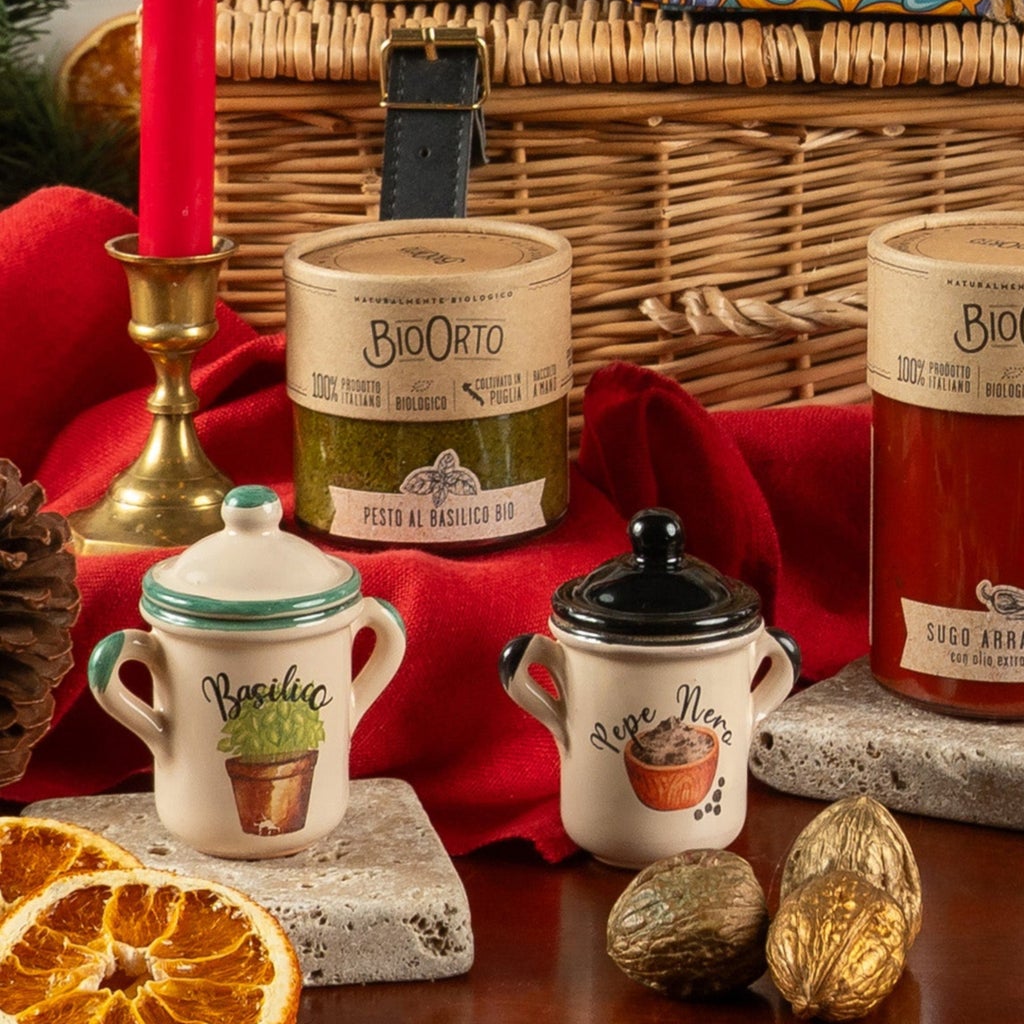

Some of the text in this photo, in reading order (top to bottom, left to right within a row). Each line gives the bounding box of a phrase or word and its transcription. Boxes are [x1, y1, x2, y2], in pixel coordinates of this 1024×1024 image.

[451, 290, 514, 304] BIOLOGICO
[897, 355, 926, 387] 100%
[928, 361, 972, 379] PRODOTTO
[312, 372, 338, 403] 100%
[341, 377, 381, 394] PRODOTTO
[475, 374, 512, 391] COLTIVATO
[928, 378, 972, 394] ITALIANO
[341, 392, 381, 408] ITALIANO
[395, 395, 448, 411] BIOLOGICO
[490, 386, 522, 406] PUGLIA
[363, 501, 515, 528] PESTO AL BASILICO BIO
[926, 622, 971, 648] SUGO
[950, 651, 968, 666] con
[973, 649, 993, 667] olio
[201, 664, 334, 722] Basilico
[590, 683, 733, 755] Pepe Nero
